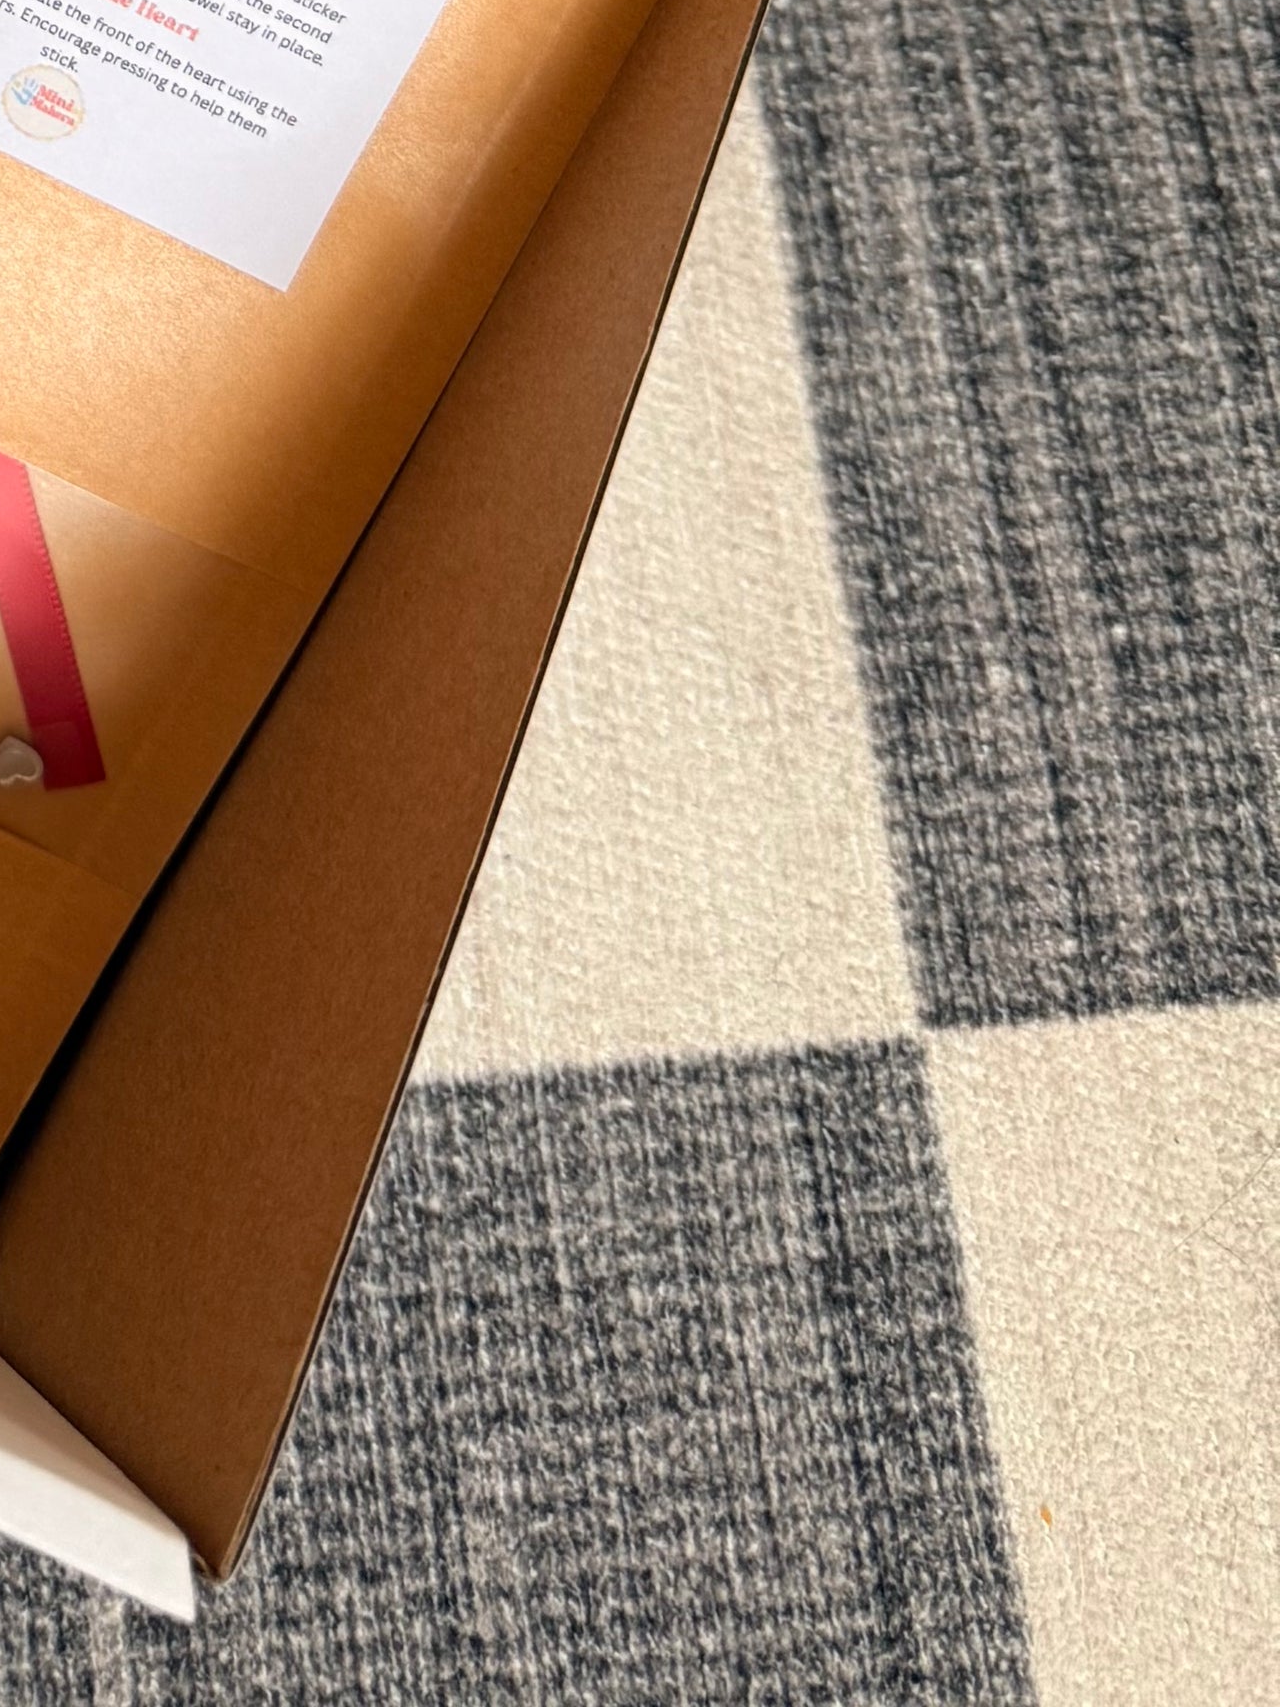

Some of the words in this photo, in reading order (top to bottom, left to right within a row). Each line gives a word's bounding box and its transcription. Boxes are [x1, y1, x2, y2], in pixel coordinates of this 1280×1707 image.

[64, 3, 92, 26] the
[93, 16, 134, 47] front
[134, 40, 156, 55] of
[154, 48, 182, 70] the
[182, 61, 227, 92] heart
[226, 85, 269, 116] using
[270, 105, 298, 127] the
